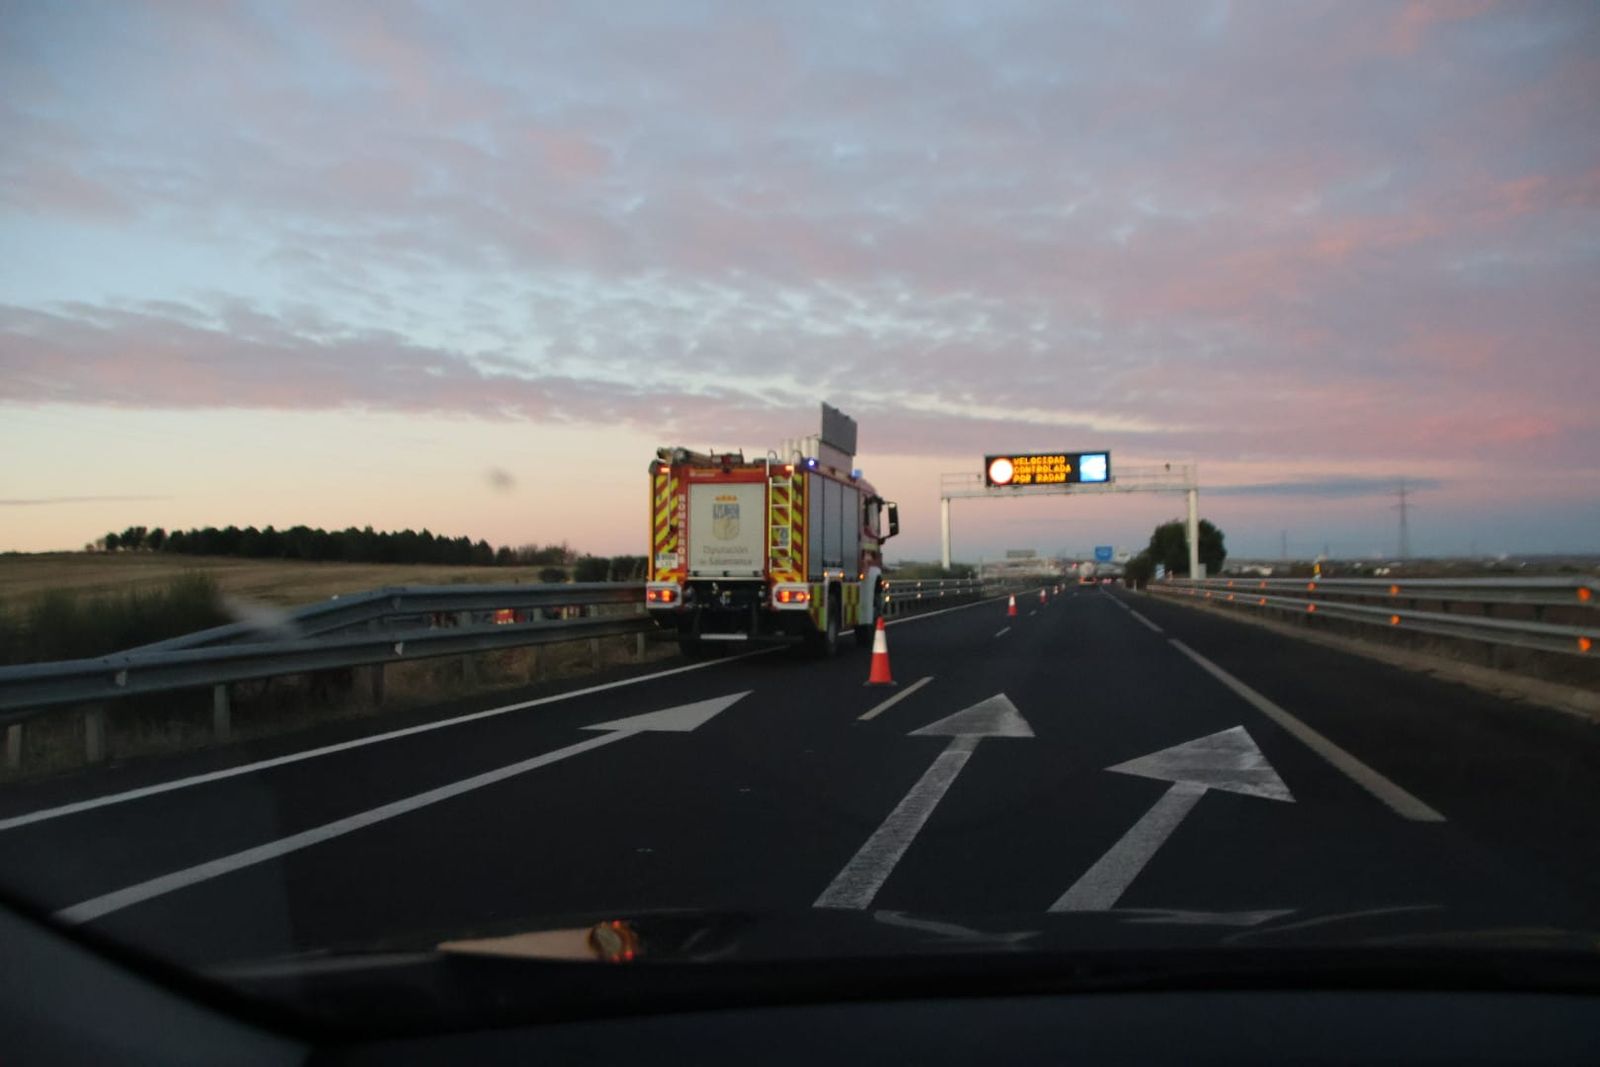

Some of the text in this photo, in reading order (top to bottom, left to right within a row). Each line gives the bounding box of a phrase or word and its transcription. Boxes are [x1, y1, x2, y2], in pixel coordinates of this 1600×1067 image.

[1013, 456, 1065, 465] VELOCIDAD
[1014, 464, 1071, 474] CONTROLADA
[1013, 473, 1065, 483] POR RADAR
